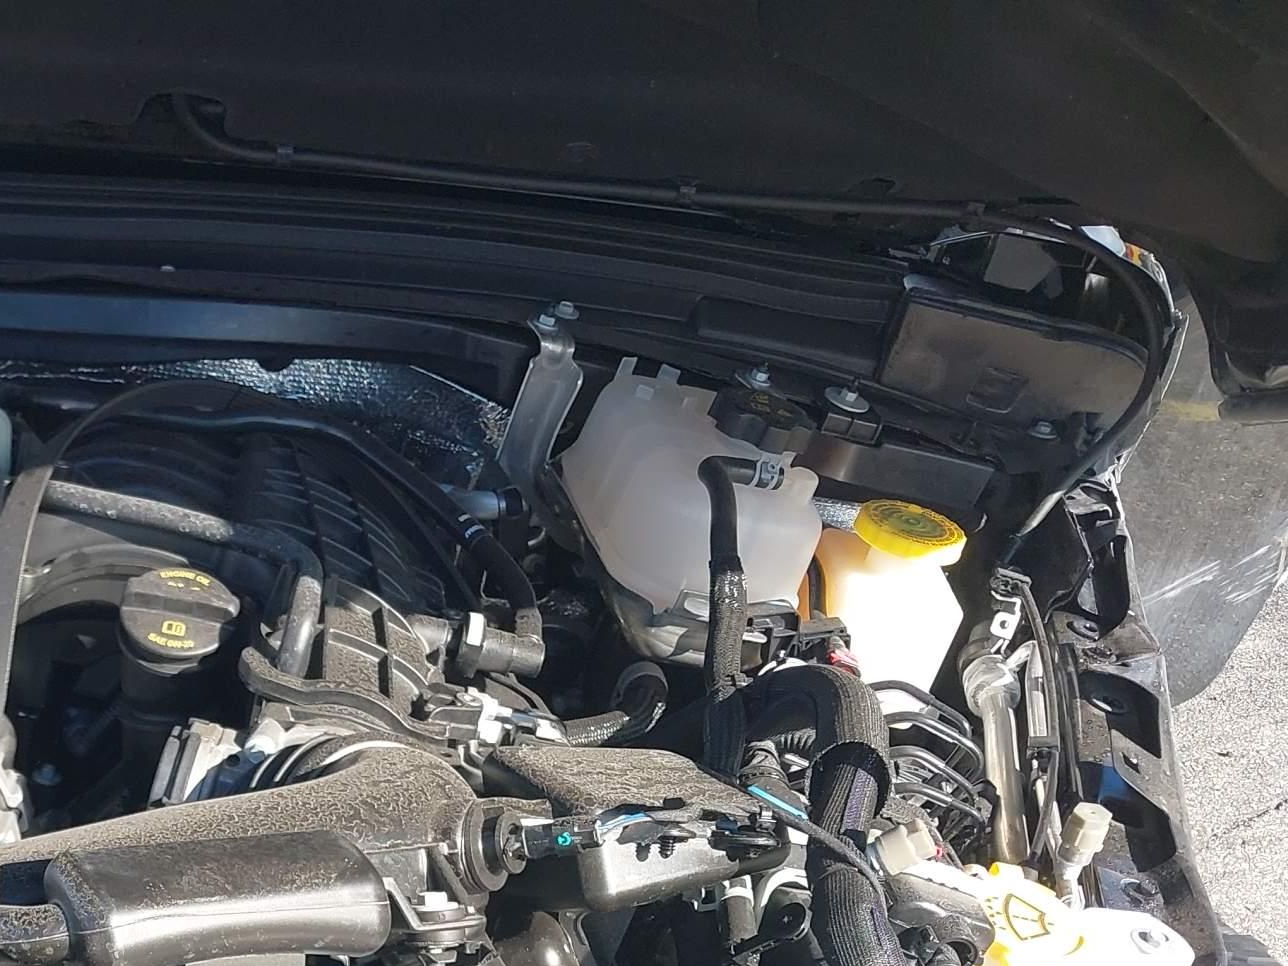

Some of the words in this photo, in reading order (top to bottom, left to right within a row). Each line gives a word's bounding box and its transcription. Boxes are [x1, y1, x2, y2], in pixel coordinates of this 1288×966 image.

[159, 571, 196, 580] ENGINE
[196, 575, 210, 586] OIL
[147, 633, 168, 646] SAE
